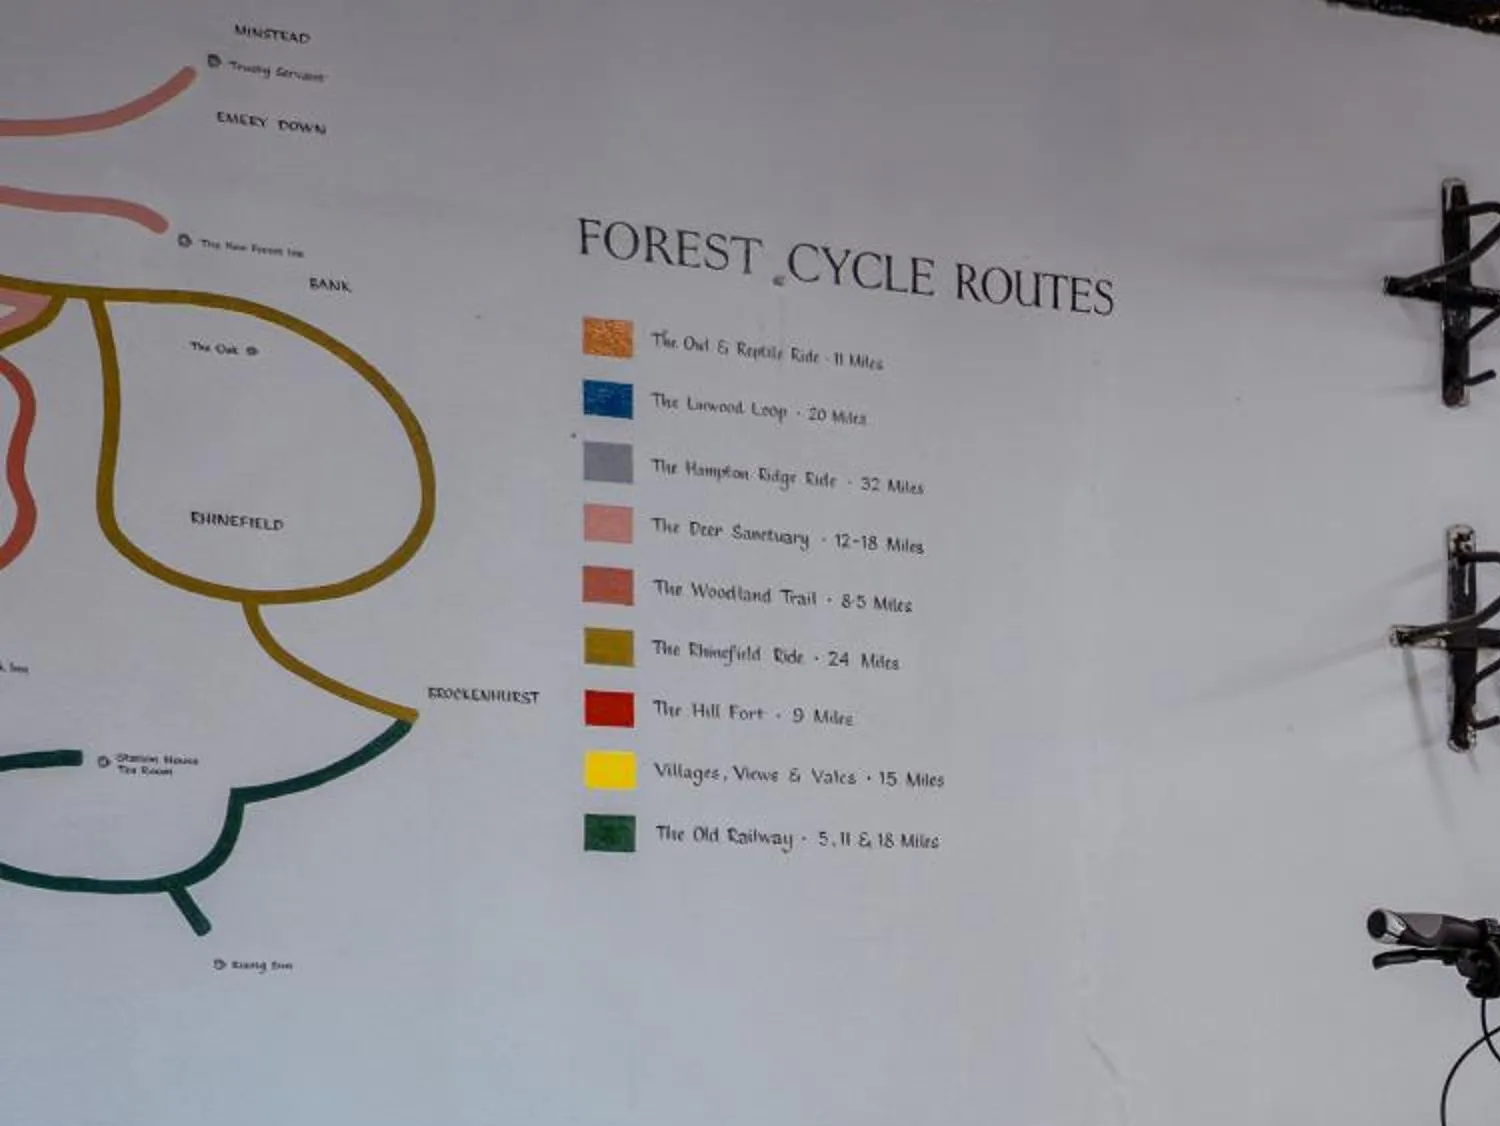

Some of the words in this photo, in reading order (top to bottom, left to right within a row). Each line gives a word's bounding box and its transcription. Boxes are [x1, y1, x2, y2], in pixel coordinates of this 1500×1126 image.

[234, 23, 312, 45] MINSTEAD
[216, 111, 269, 128] EMERY
[277, 119, 327, 136] DOWN
[577, 217, 763, 275] FOREST
[787, 242, 935, 297] CYCLE
[955, 262, 1115, 317] ROUTES
[308, 276, 352, 294] BANK
[650, 328, 677, 349] The
[683, 335, 710, 353] Owl
[716, 338, 729, 356] &
[736, 340, 784, 361] Reptile
[790, 346, 820, 364] Ride
[833, 351, 844, 367] 11
[849, 352, 884, 371] Miles
[650, 391, 679, 410] The
[750, 401, 788, 425] Loop
[807, 406, 828, 422] 20
[831, 409, 867, 426] Miles
[650, 457, 678, 476] The
[684, 459, 750, 483] Hampton
[757, 466, 797, 492] Ridge
[804, 471, 838, 489] Ride
[860, 476, 881, 492] 32
[887, 478, 925, 495] Miles
[190, 510, 285, 532] RHINEFIELD
[649, 516, 681, 534] The
[689, 520, 724, 537] Deer
[730, 523, 810, 551] Sanctuary
[885, 536, 925, 555] Miles
[651, 578, 683, 597] The
[690, 581, 772, 604] Woodland
[778, 588, 817, 607] Trail
[873, 595, 913, 614] Miles
[650, 639, 681, 657] The
[772, 646, 804, 665] Ride
[827, 650, 850, 667] 24
[860, 652, 900, 671] Miles
[652, 699, 683, 718] The
[691, 702, 721, 719] Hill
[728, 703, 764, 721] Fort
[792, 707, 805, 724] 9
[813, 708, 855, 727] Miles
[731, 764, 779, 783] Views
[788, 767, 802, 784] &
[810, 767, 857, 785] Vales
[879, 771, 898, 786] 15
[905, 771, 945, 789] Miles
[655, 824, 686, 843] The
[692, 825, 720, 843] Old
[726, 826, 794, 855] Railway
[839, 831, 851, 847] 11
[857, 831, 873, 849] &
[877, 831, 895, 849] 18
[900, 832, 940, 849] Miles
